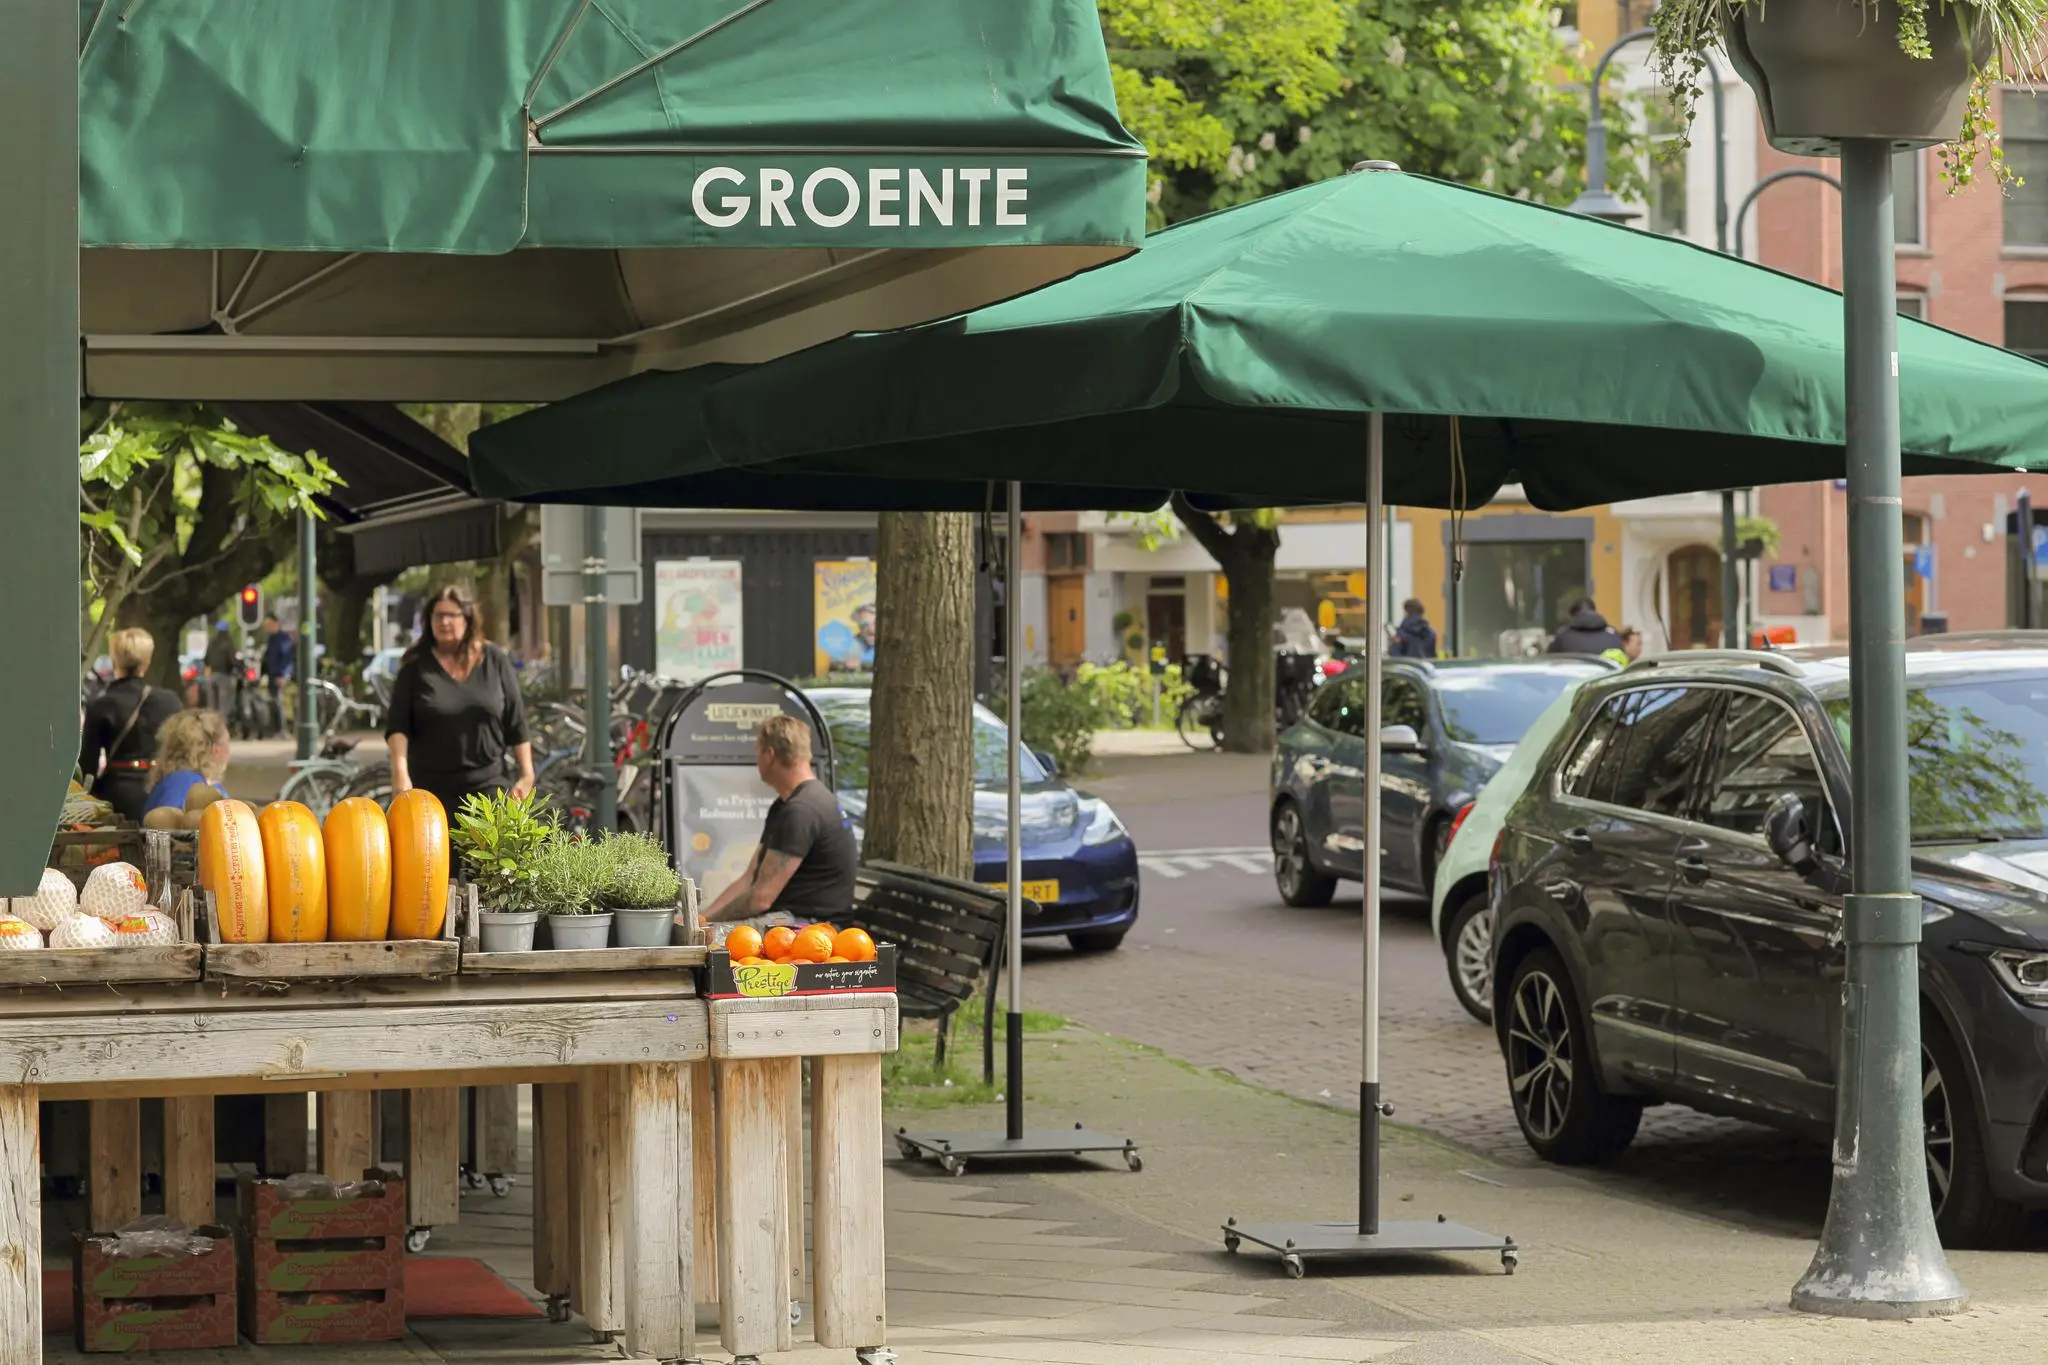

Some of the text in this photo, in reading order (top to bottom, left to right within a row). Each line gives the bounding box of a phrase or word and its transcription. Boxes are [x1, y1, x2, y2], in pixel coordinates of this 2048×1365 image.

[691, 166, 1028, 228] GROENTE
[737, 966, 794, 995] Prestige
[289, 1211, 375, 1225] Pomegranates
[113, 1268, 200, 1282] Pomegranates
[287, 1263, 374, 1277] Pomegranates
[115, 1321, 201, 1335] Pomegranates
[286, 1315, 372, 1329] Pomegranates
